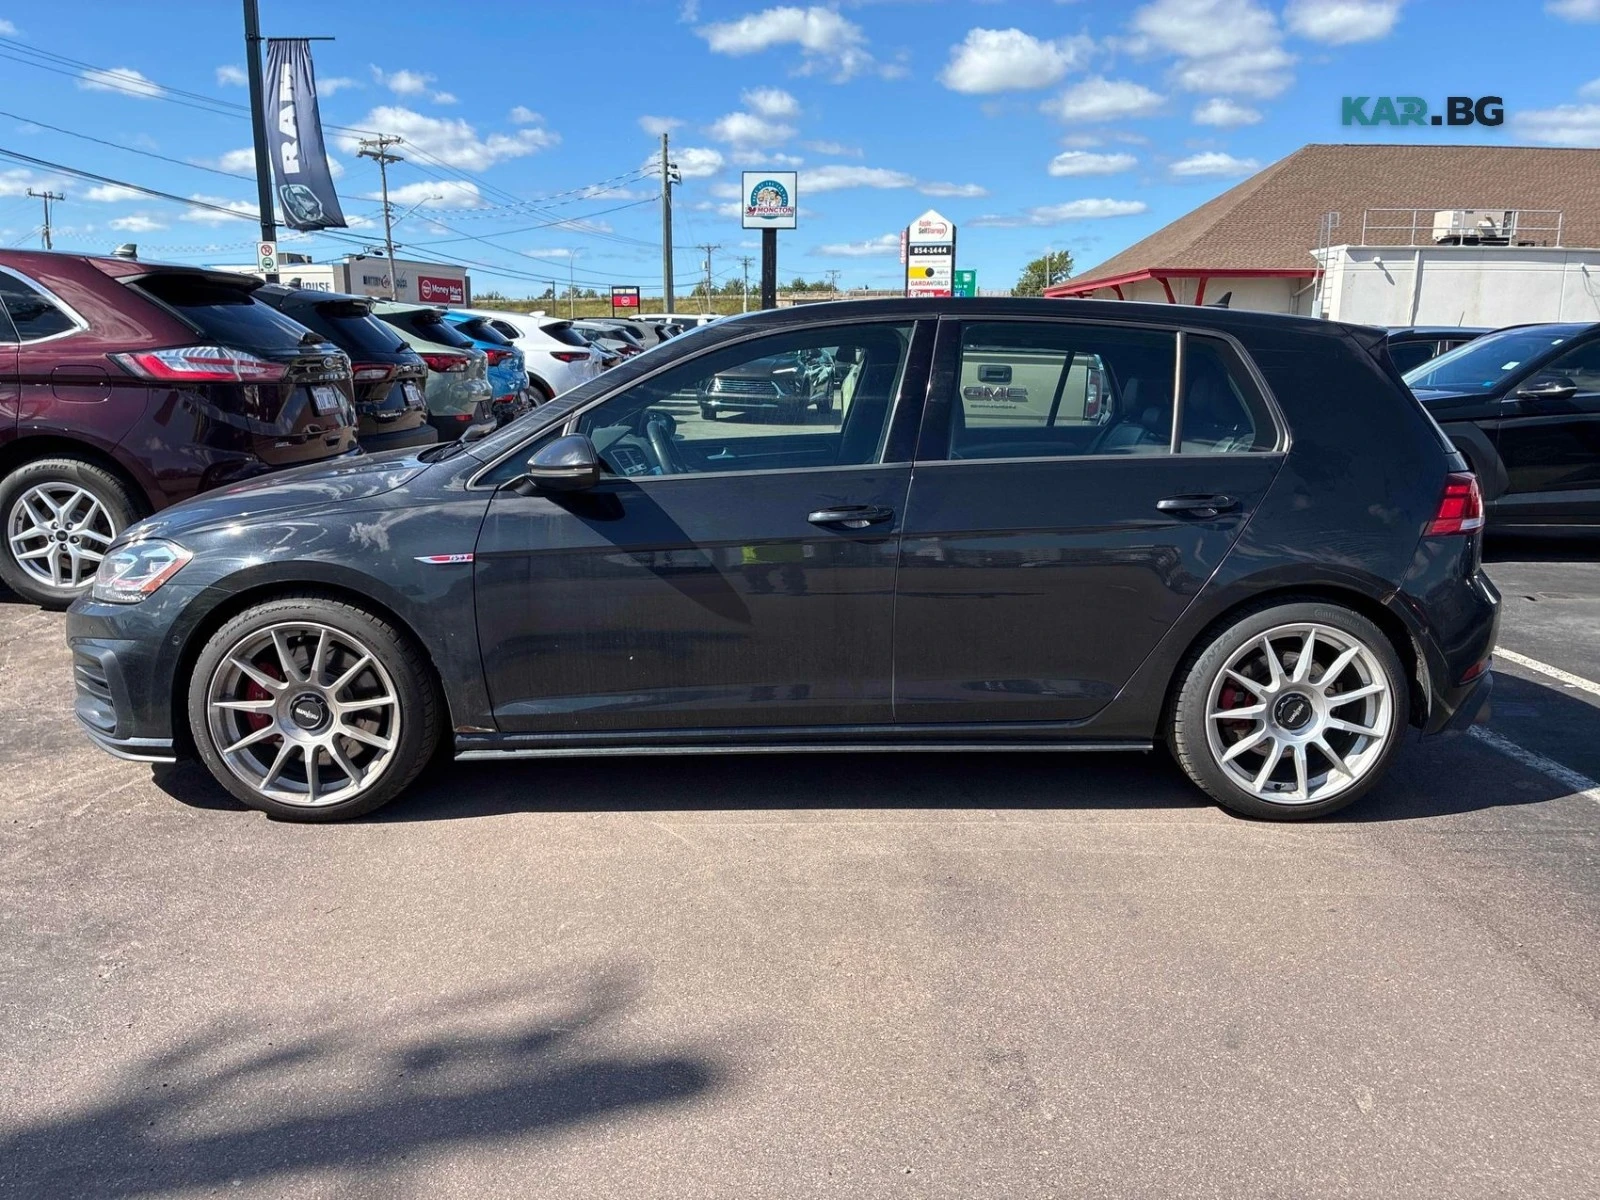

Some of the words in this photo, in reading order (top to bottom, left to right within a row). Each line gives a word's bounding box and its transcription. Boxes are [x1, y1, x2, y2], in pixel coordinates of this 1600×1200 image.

[278, 63, 300, 174] RAM
[431, 284, 449, 296] Money
[450, 286, 462, 295] Mart
[963, 386, 1029, 403] GMC
